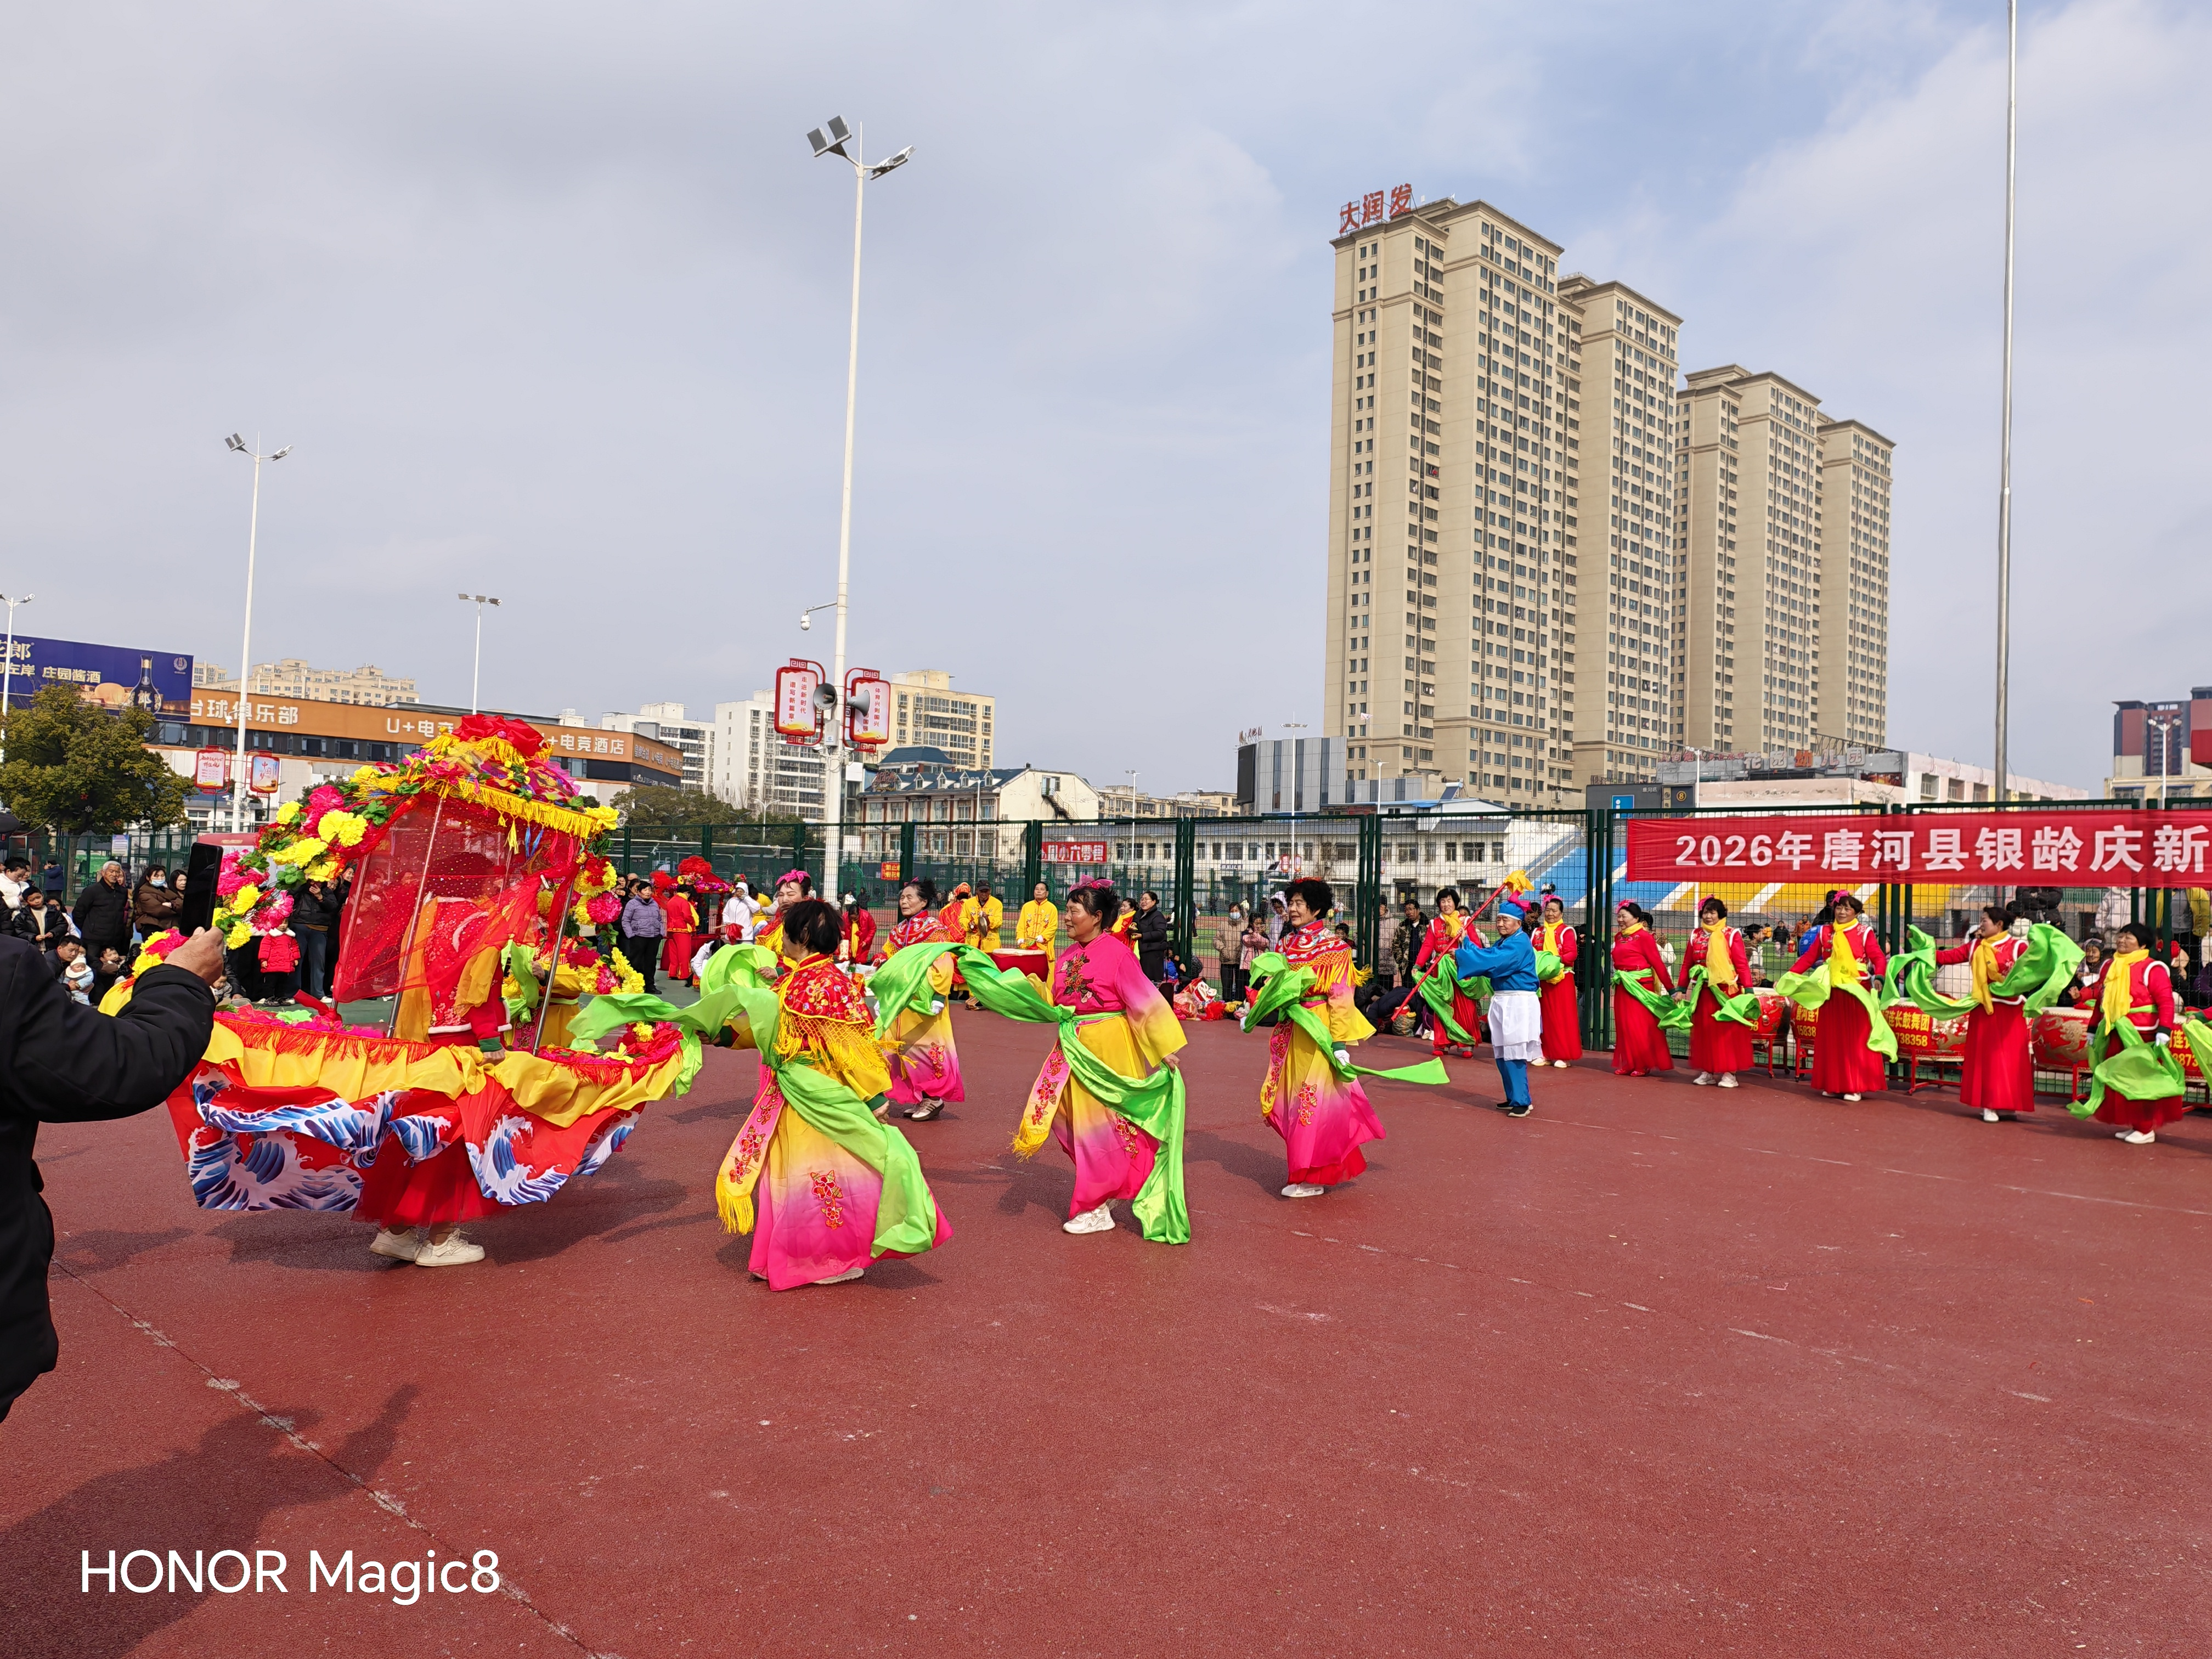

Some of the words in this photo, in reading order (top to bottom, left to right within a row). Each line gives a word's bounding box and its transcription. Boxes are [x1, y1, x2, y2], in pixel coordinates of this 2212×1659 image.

[1339, 183, 1412, 234] 大润发
[42, 666, 101, 684] 庄园酱酒
[191, 699, 298, 725] 台球俱乐部
[1743, 747, 1865, 769] 花园幼儿园
[1675, 825, 2210, 873] 2026年唐河县银龄庆新
[1797, 1025, 1816, 1037] 15838
[1895, 1032, 1928, 1047] 738358
